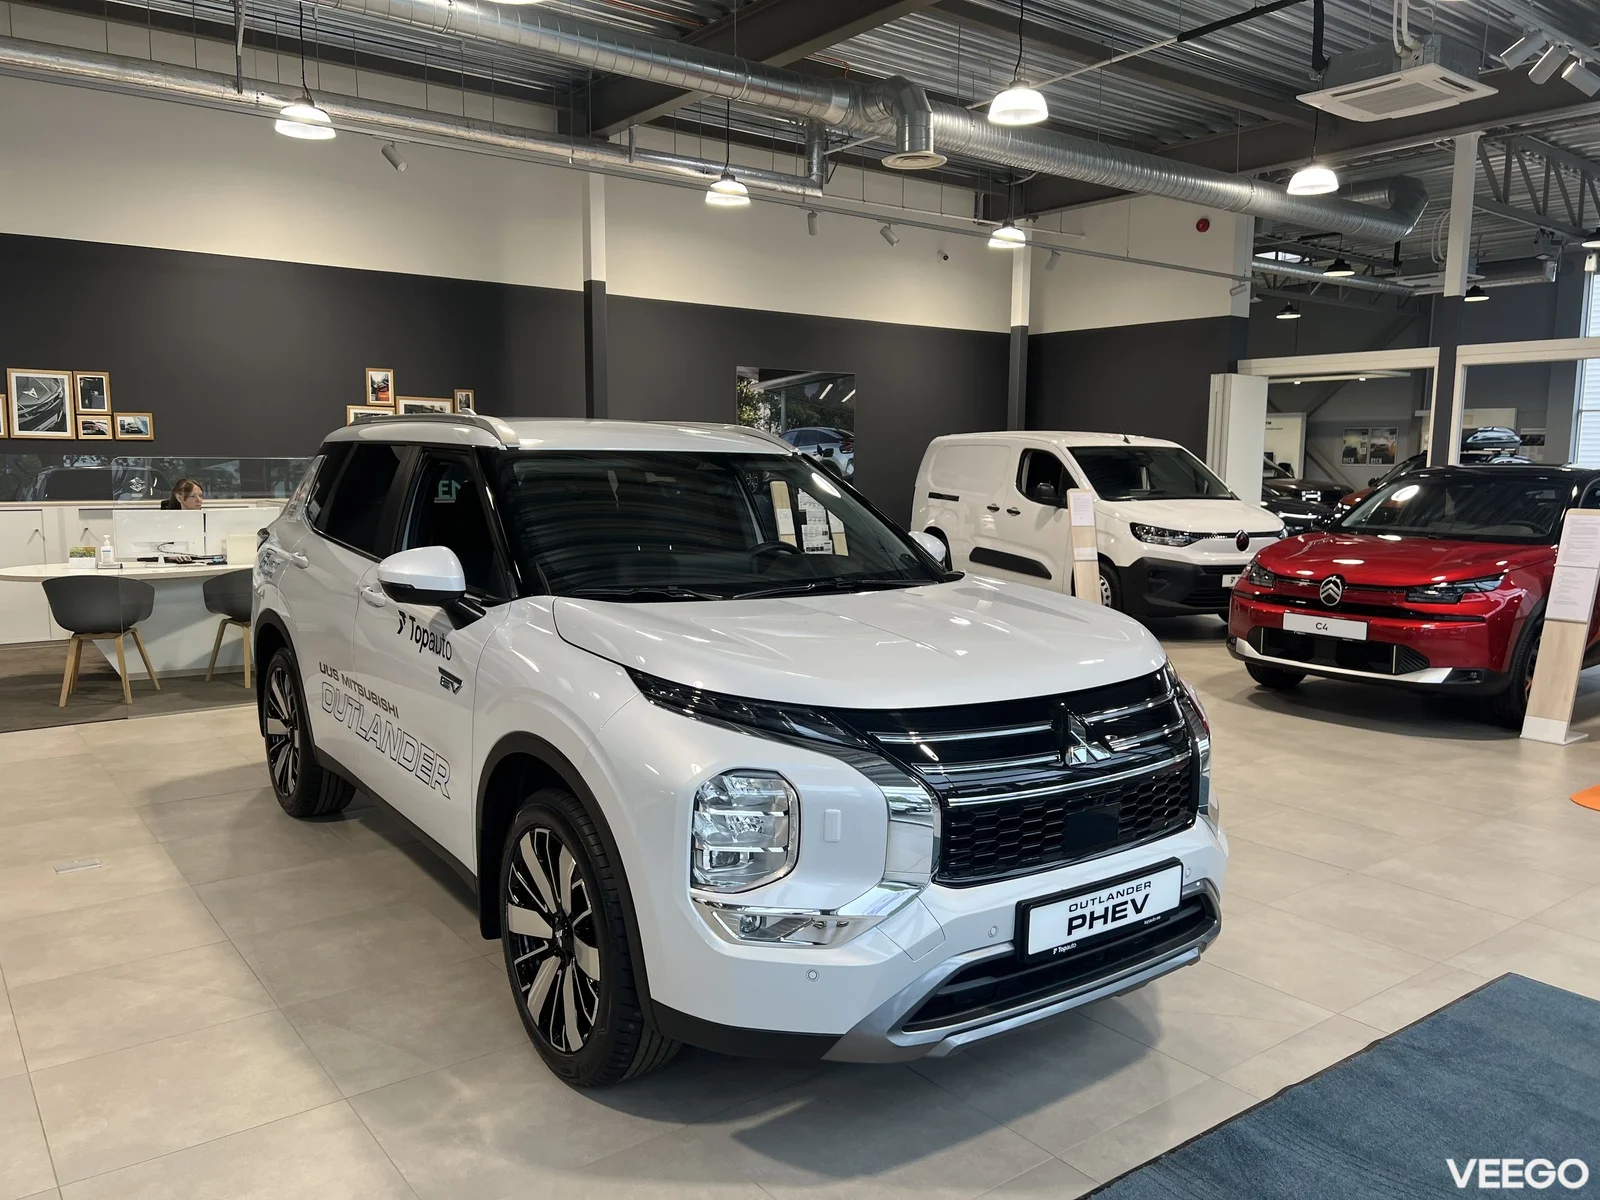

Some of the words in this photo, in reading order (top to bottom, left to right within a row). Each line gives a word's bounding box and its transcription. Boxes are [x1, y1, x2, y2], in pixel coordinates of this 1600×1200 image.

[409, 615, 453, 661] Topauto
[1315, 622, 1328, 631] C4
[319, 662, 340, 682] UUS
[341, 674, 399, 719] MITSUBISHI
[440, 675, 463, 695] EV
[321, 682, 451, 799] OUTLANDER
[1067, 893, 1150, 936] PHEV
[1069, 881, 1151, 912] OUTLANDER
[1058, 943, 1077, 953] Topauto
